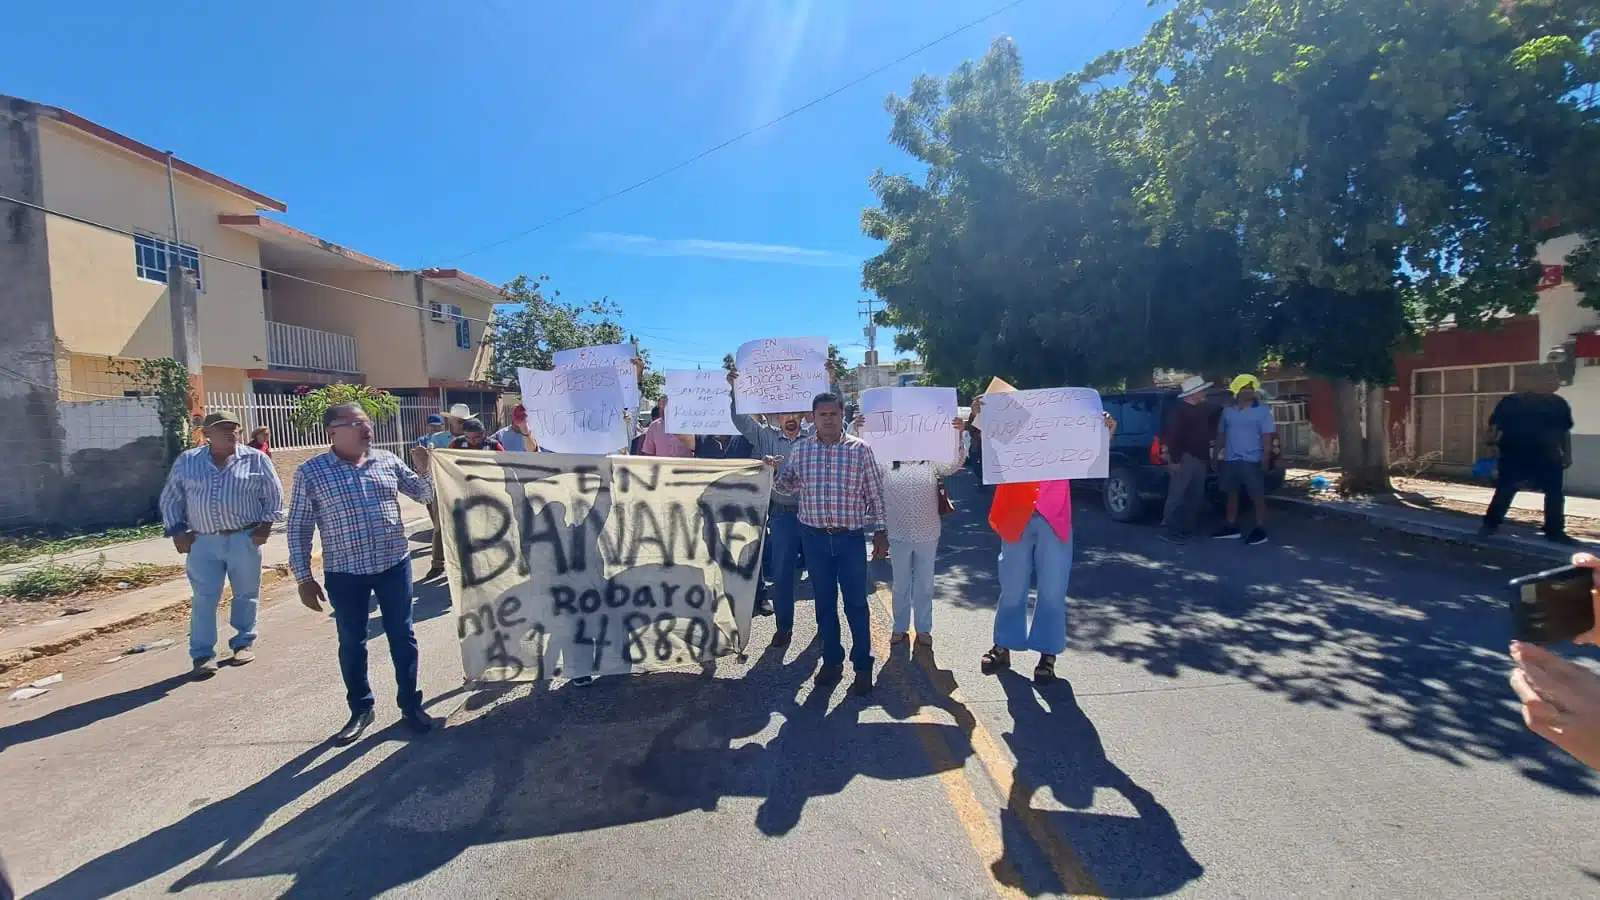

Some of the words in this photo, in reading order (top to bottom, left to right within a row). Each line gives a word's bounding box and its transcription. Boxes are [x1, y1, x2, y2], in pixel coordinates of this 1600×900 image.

[764, 338, 777, 348] EN
[870, 410, 951, 440] JUSTICIA
[572, 463, 661, 495] EN
[458, 595, 527, 639] me
